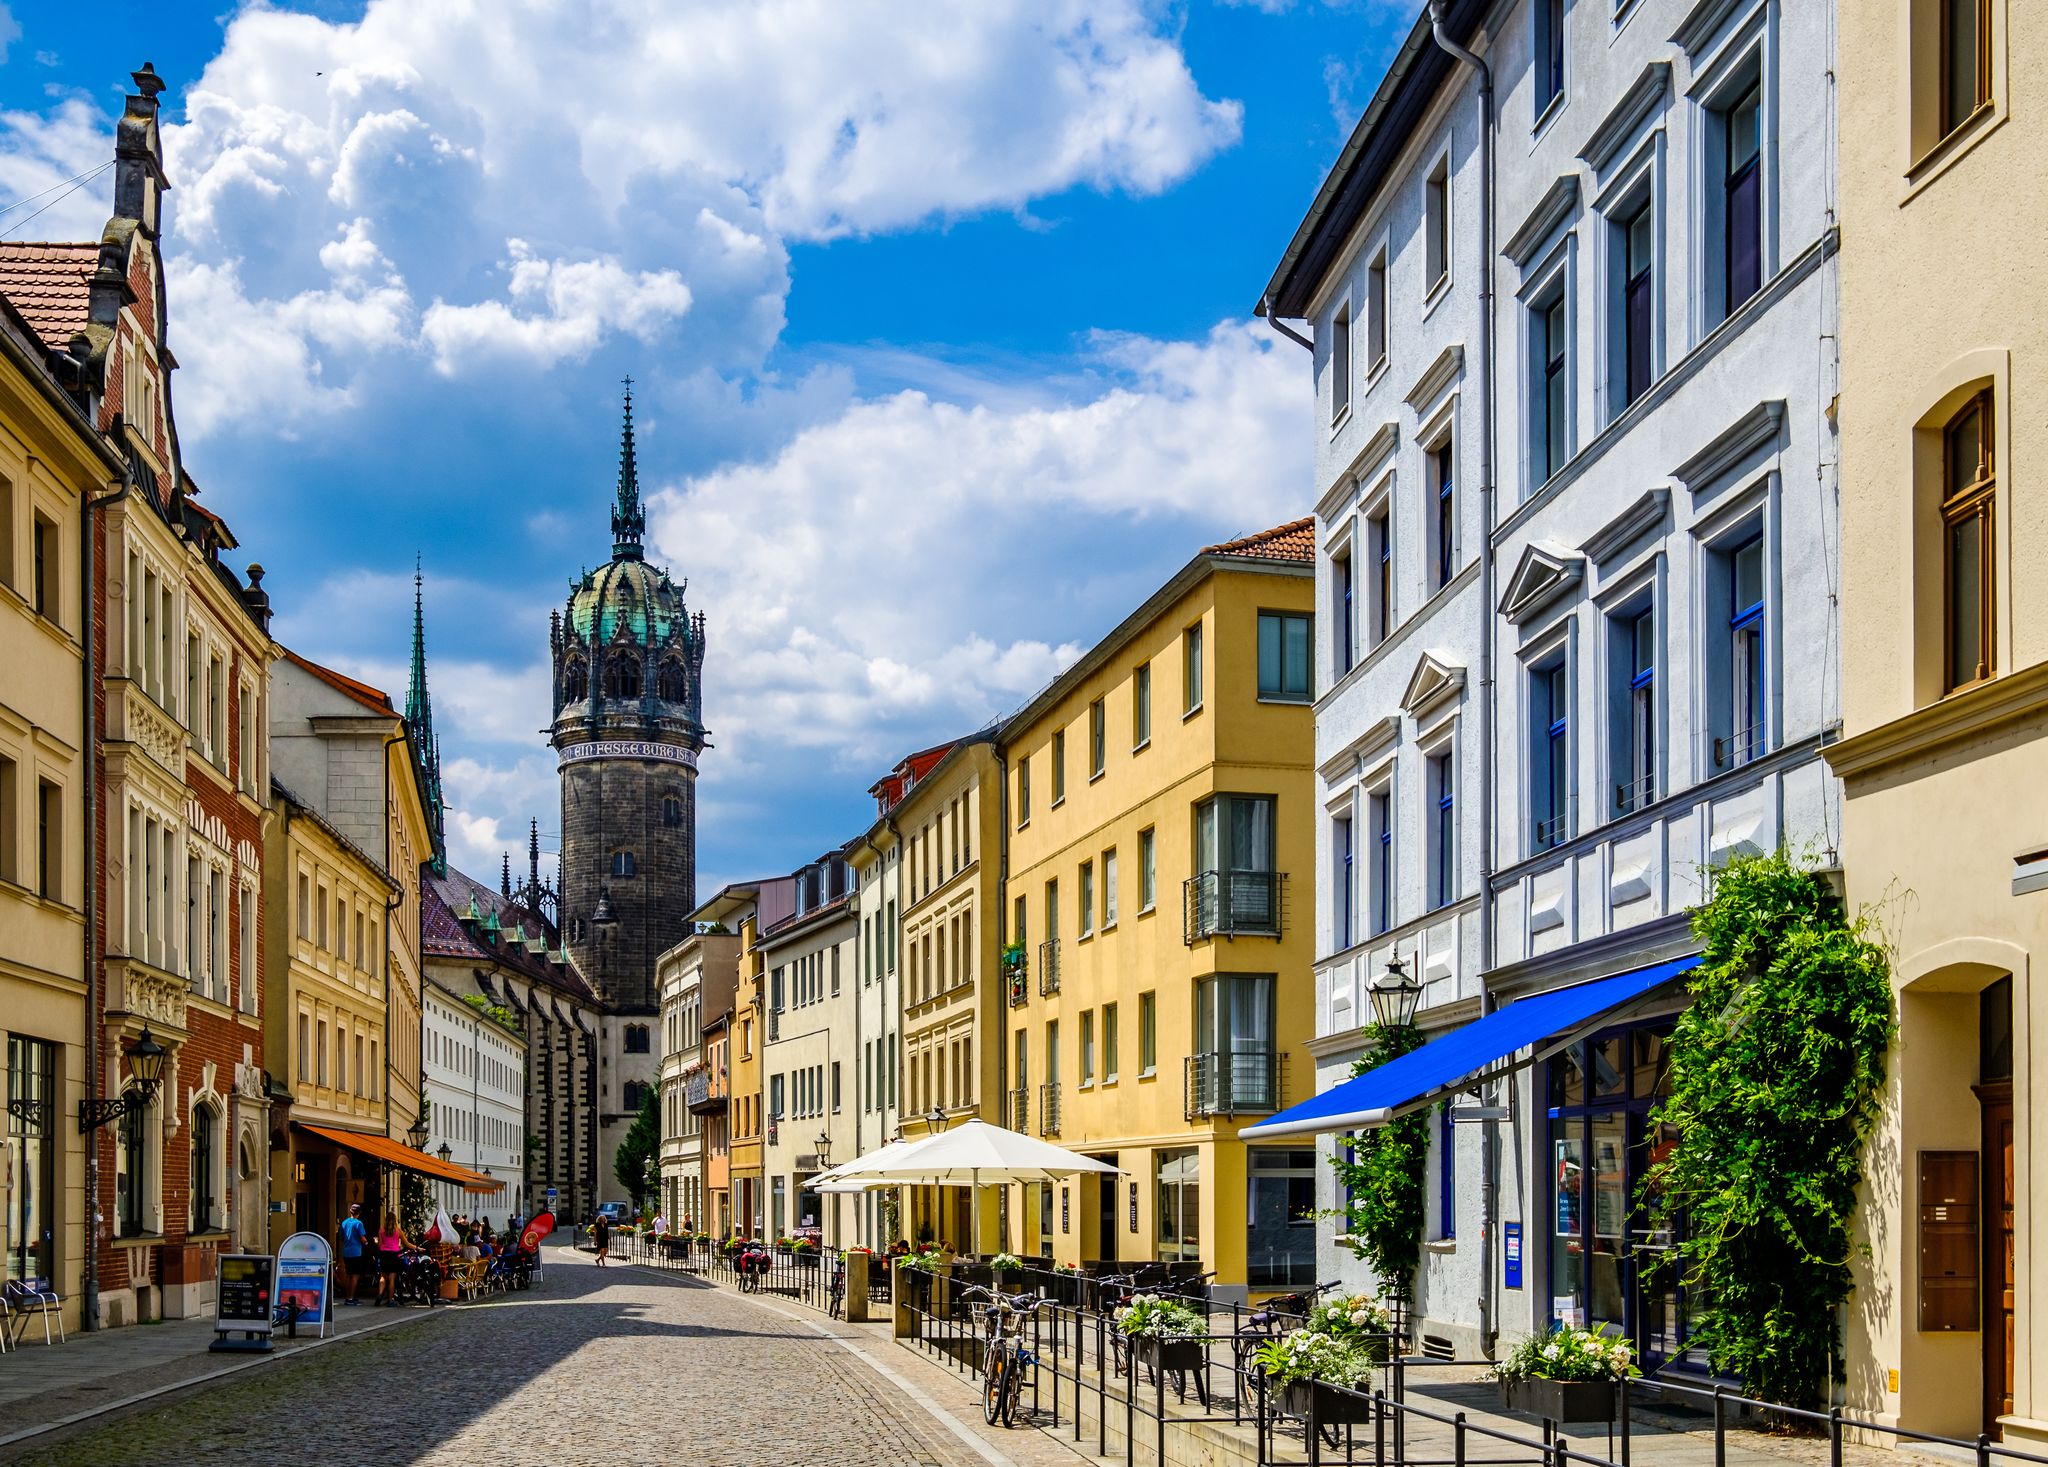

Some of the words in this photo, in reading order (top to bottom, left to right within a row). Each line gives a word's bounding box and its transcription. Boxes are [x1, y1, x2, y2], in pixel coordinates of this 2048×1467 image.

[574, 744, 593, 758] EIN
[596, 743, 639, 755] FESTE
[642, 744, 674, 758] BURG
[676, 748, 689, 762] IST
